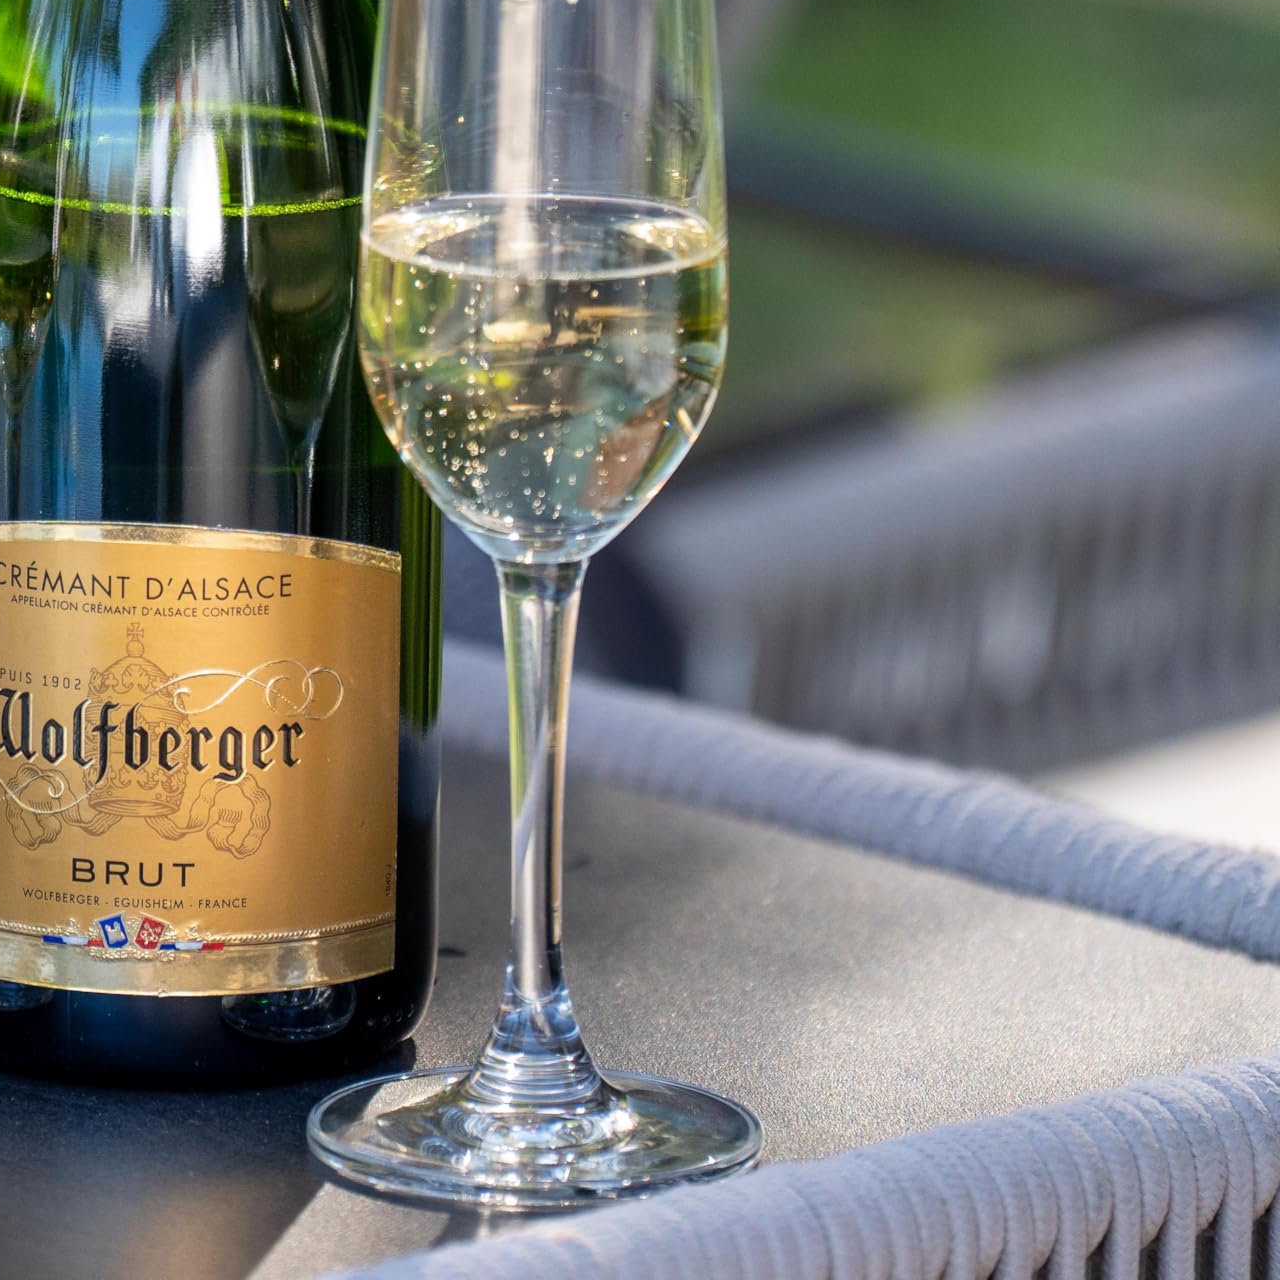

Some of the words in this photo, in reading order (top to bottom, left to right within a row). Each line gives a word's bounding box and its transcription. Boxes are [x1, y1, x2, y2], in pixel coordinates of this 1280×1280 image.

[146, 574, 292, 601] D'ALSACE
[10, 594, 78, 612] APPELLATION
[82, 601, 137, 617] CRÉMANT
[141, 606, 197, 618] D'ALSACE
[202, 602, 270, 617] CONTRÔLÉE
[42, 674, 82, 691] 1902
[72, 858, 195, 888] BRUT
[22, 888, 100, 907] WOLFBERGER
[114, 897, 184, 910] EGUISHEIM
[198, 897, 248, 909] FRANCE
